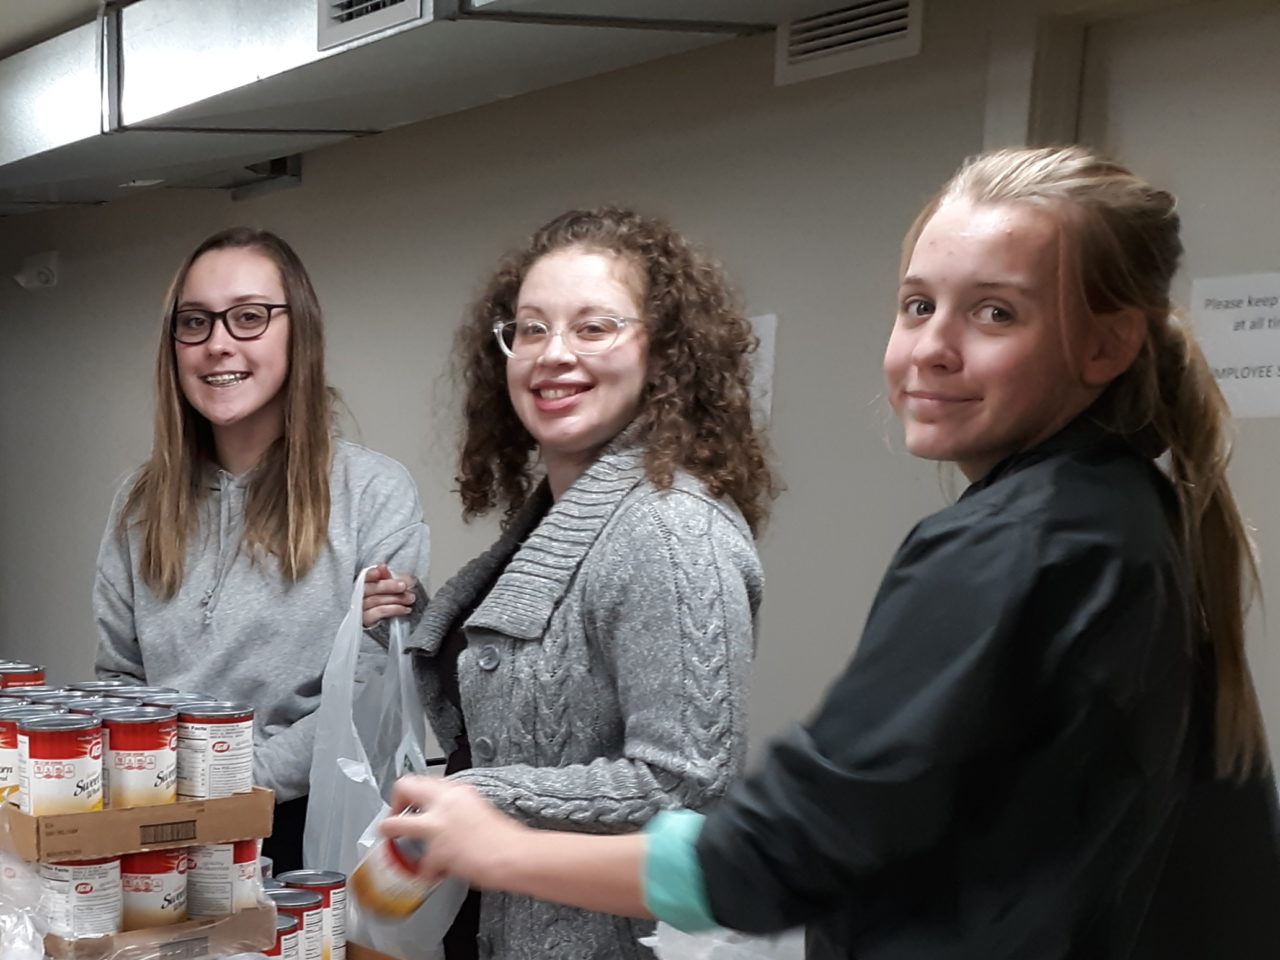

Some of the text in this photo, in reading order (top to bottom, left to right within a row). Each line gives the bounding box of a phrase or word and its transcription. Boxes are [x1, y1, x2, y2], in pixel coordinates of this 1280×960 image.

[1204, 295, 1279, 310] Please keep
[1212, 365, 1273, 379] MPLOYEE
